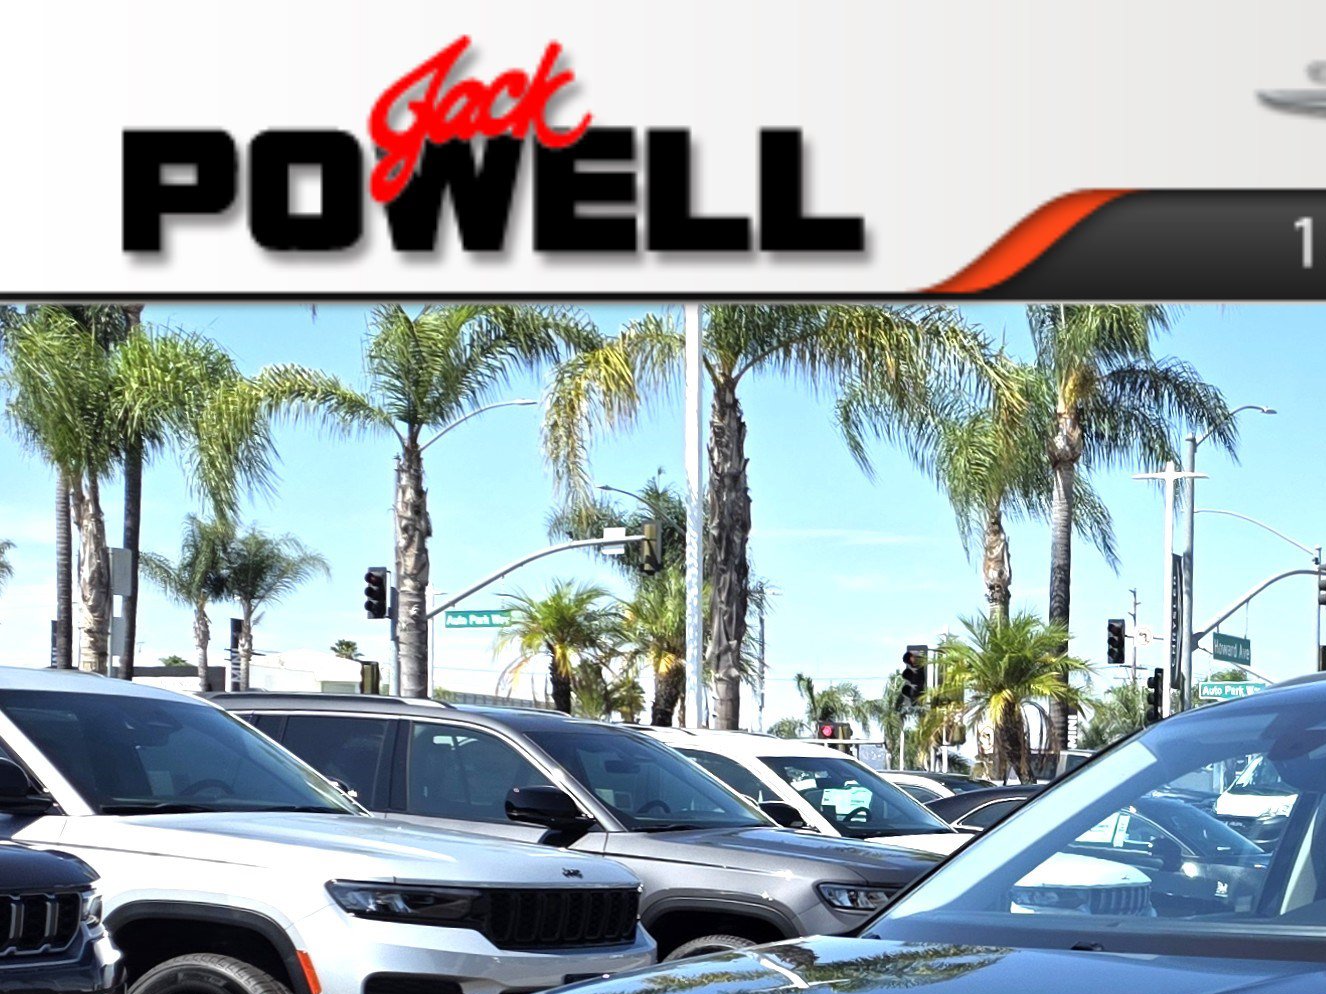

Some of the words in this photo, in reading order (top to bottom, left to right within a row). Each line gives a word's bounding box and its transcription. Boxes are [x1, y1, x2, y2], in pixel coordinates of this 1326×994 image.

[1214, 638, 1238, 659] Howard
[1202, 685, 1223, 696] Auto
[1224, 684, 1245, 697] Park
